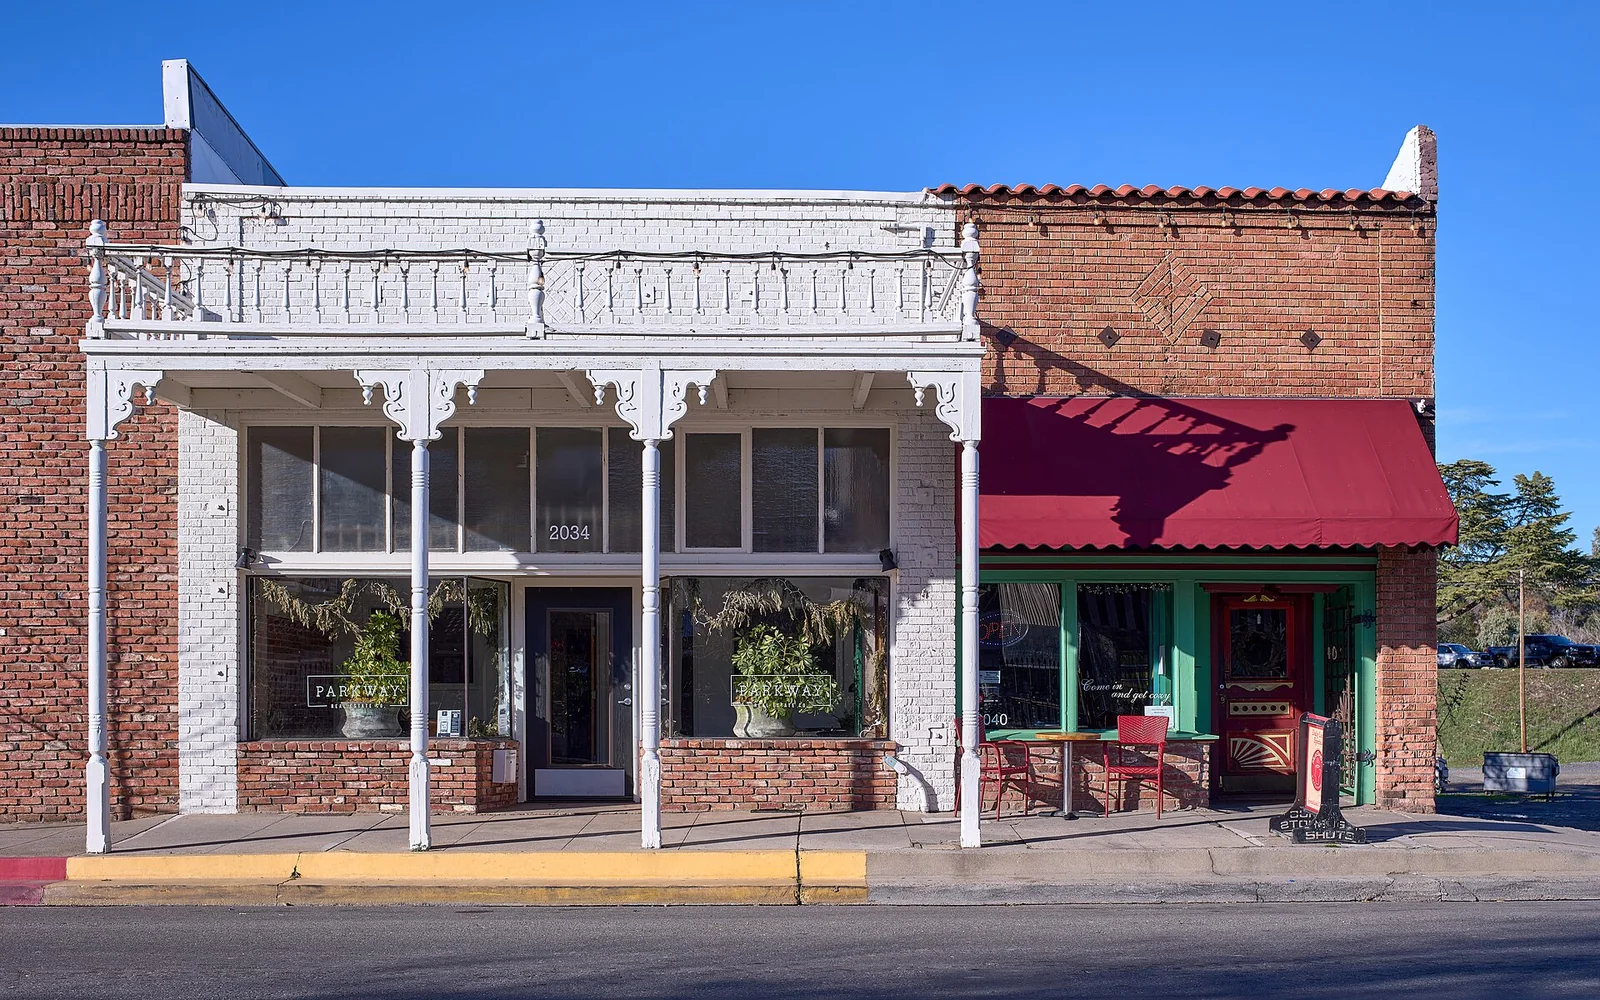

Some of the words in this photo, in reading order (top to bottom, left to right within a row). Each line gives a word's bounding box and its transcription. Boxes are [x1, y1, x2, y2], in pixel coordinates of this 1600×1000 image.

[549, 525, 590, 540] 2034
[316, 685, 399, 698] PARKWAY
[739, 685, 822, 697] PARKWAY
[1081, 679, 1110, 691] Come
[1112, 681, 1123, 690] in
[1111, 688, 1133, 699] and
[1131, 690, 1148, 704] get
[1149, 692, 1171, 703] cozy
[979, 713, 1008, 726] 040
